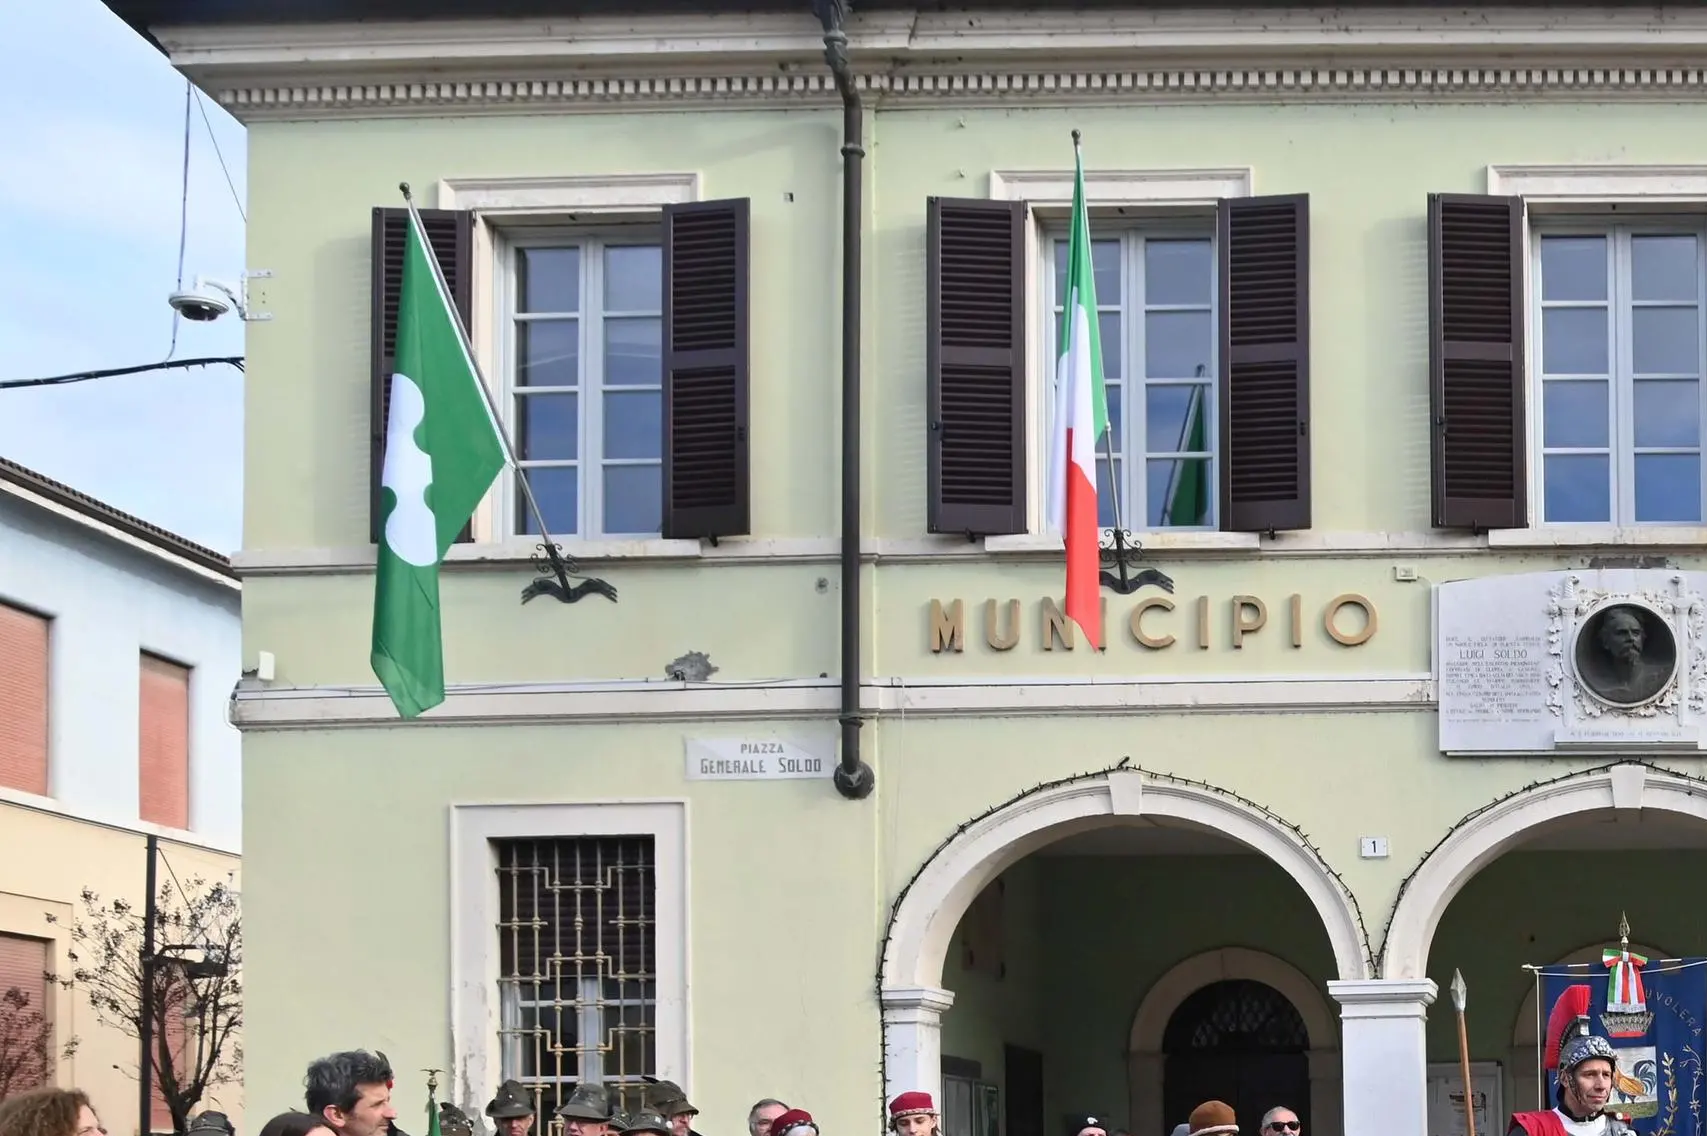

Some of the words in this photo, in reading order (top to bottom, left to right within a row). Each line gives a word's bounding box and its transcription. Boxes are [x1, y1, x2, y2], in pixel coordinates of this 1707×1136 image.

[930, 593, 1377, 653] MUNICIPIO
[1494, 649, 1528, 660] SOLDO
[740, 743, 784, 754] PIAZZA
[700, 758, 766, 774] GENERALE
[1371, 840, 1377, 853] 1
[1645, 988, 1702, 1037] UVOLERA
